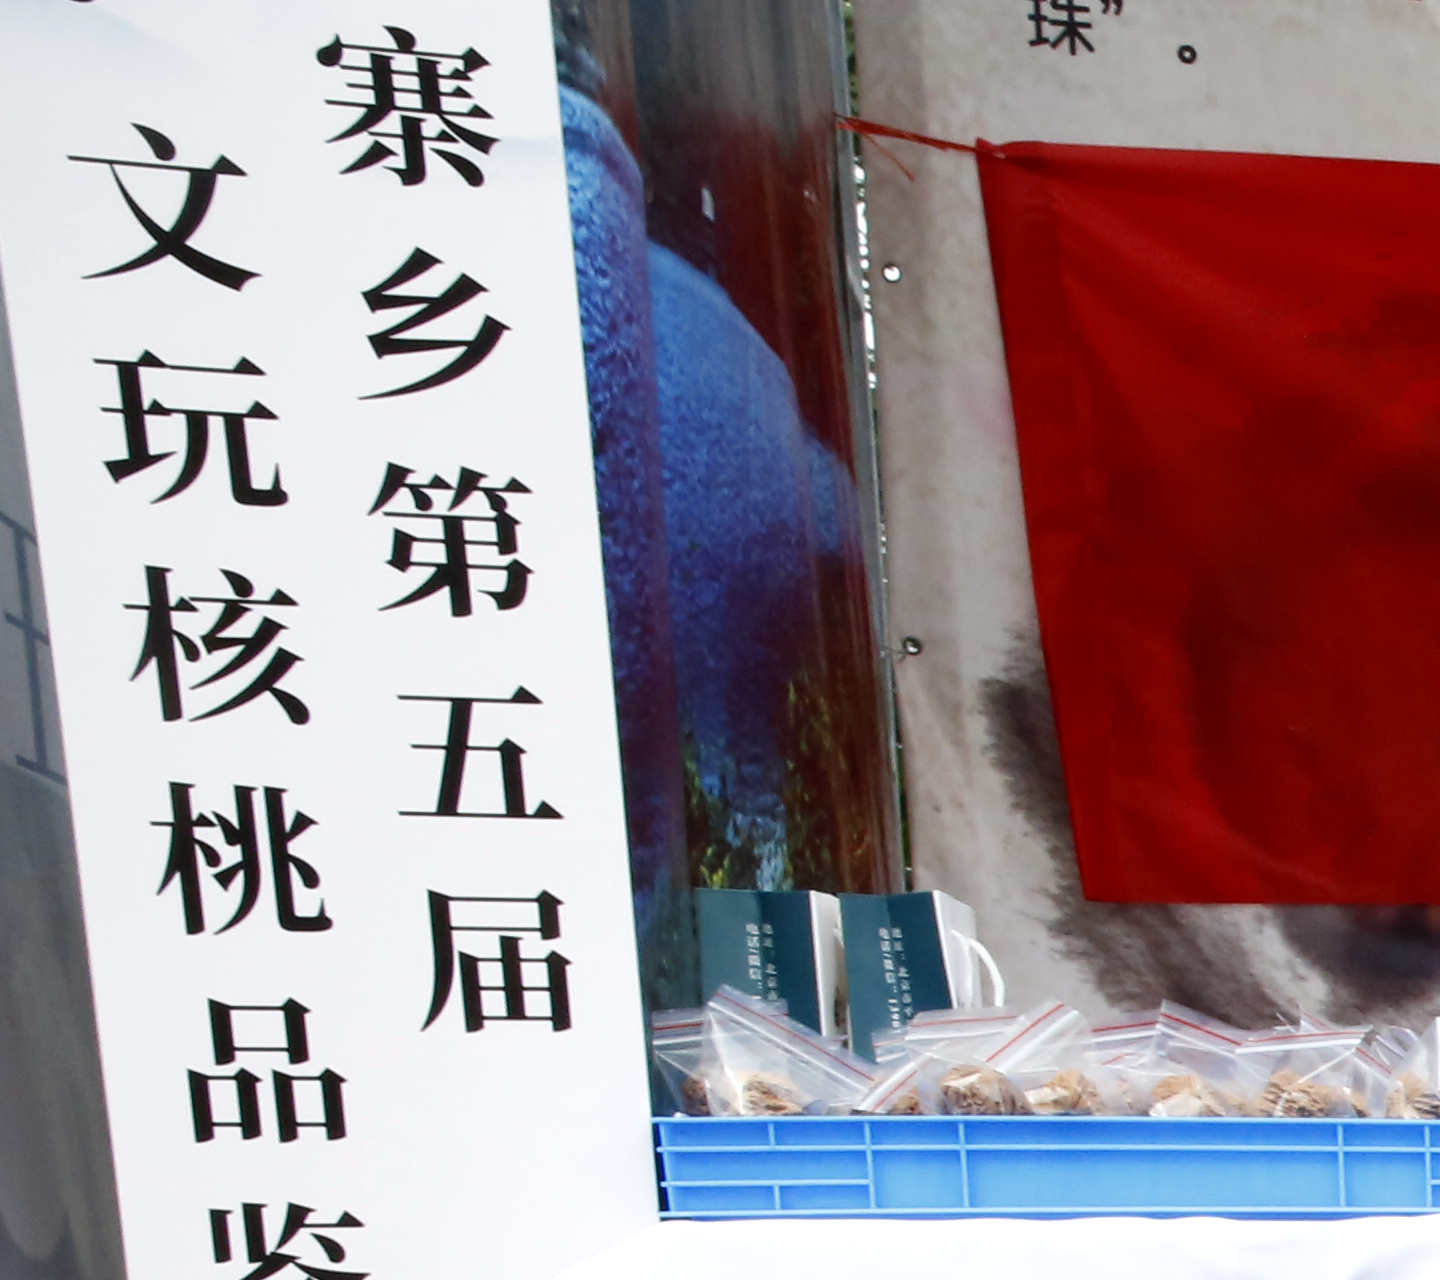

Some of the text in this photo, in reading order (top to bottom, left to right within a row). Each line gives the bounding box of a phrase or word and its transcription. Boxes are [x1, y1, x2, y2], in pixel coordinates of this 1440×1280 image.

[315, 26, 573, 1033] 寨乡第五届
